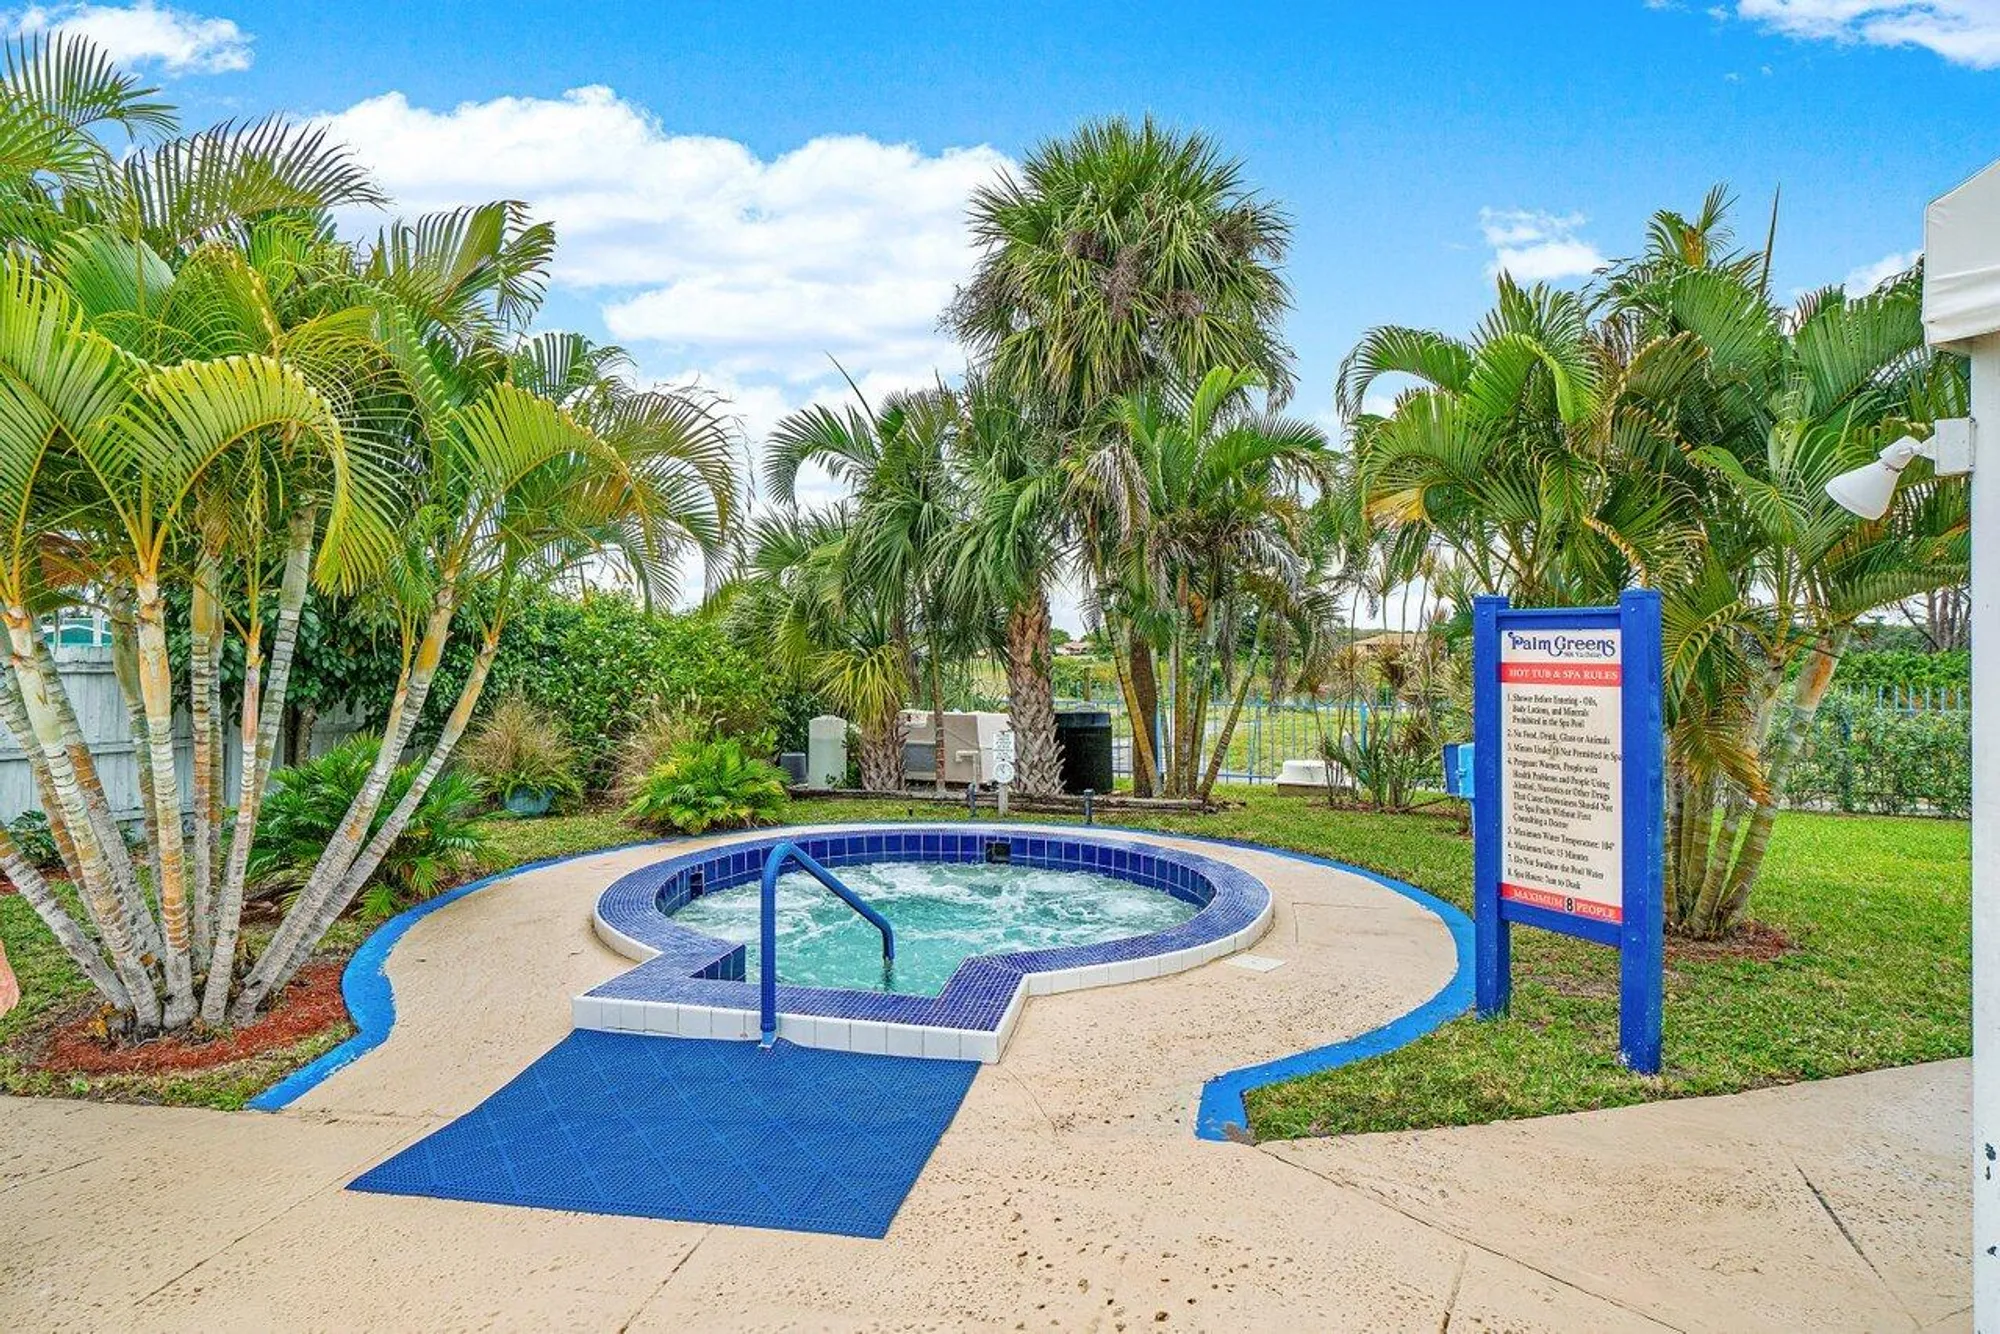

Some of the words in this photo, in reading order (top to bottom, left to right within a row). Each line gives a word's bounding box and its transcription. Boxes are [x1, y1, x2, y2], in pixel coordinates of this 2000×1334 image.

[1508, 632, 1551, 653] Palm
[1552, 635, 1616, 657] Greens
[1531, 670, 1551, 678] TUB
[1553, 670, 1561, 678] &
[1583, 671, 1618, 680] RULES
[1513, 694, 1533, 702] Shower
[1534, 695, 1552, 703] Before
[1553, 695, 1578, 706] Entering
[1564, 708, 1589, 716] Minerals
[1512, 715, 1540, 725] Prohibited
[1549, 718, 1558, 726] the
[1560, 719, 1569, 728] Spa
[1514, 730, 1522, 738] No
[1560, 733, 1576, 742] Glass
[1585, 735, 1610, 744] Animals
[1514, 743, 1533, 752] Minors
[1534, 745, 1552, 755] Under
[1561, 748, 1571, 756] Not
[1573, 749, 1602, 759] Permitted
[1564, 762, 1582, 773] People
[1585, 765, 1598, 773] with
[1513, 770, 1531, 778] Health
[1532, 772, 1559, 782] Problems
[1559, 776, 1570, 784] and
[1571, 777, 1590, 787] People
[1591, 779, 1610, 789] Using
[1513, 792, 1525, 800] That
[1527, 793, 1543, 802] Cause
[1545, 796, 1578, 807] Drowsiness
[1578, 799, 1599, 810] Should
[1600, 802, 1613, 812] Not
[1573, 788, 1590, 797] Other
[1591, 790, 1610, 801] Drugs
[1525, 804, 1535, 813] Spa
[1577, 811, 1592, 820] First
[1512, 813, 1543, 826] Consulting
[1549, 818, 1568, 828] Doctor
[1514, 827, 1542, 839] Maximum
[1543, 832, 1560, 841] Water
[1514, 842, 1541, 853] Maximum
[1565, 850, 1588, 861] Minutes
[1525, 857, 1534, 866] Not
[1536, 859, 1559, 869] Swallow
[1560, 863, 1570, 872] the
[1571, 865, 1584, 875] Pool
[1586, 869, 1604, 879] Water
[1514, 869, 1524, 879] Spa
[1566, 879, 1580, 889] Dusk
[1513, 890, 1564, 907] MAXIMUM
[1566, 897, 1573, 911] 8
[1576, 905, 1616, 919] PEOPLE
